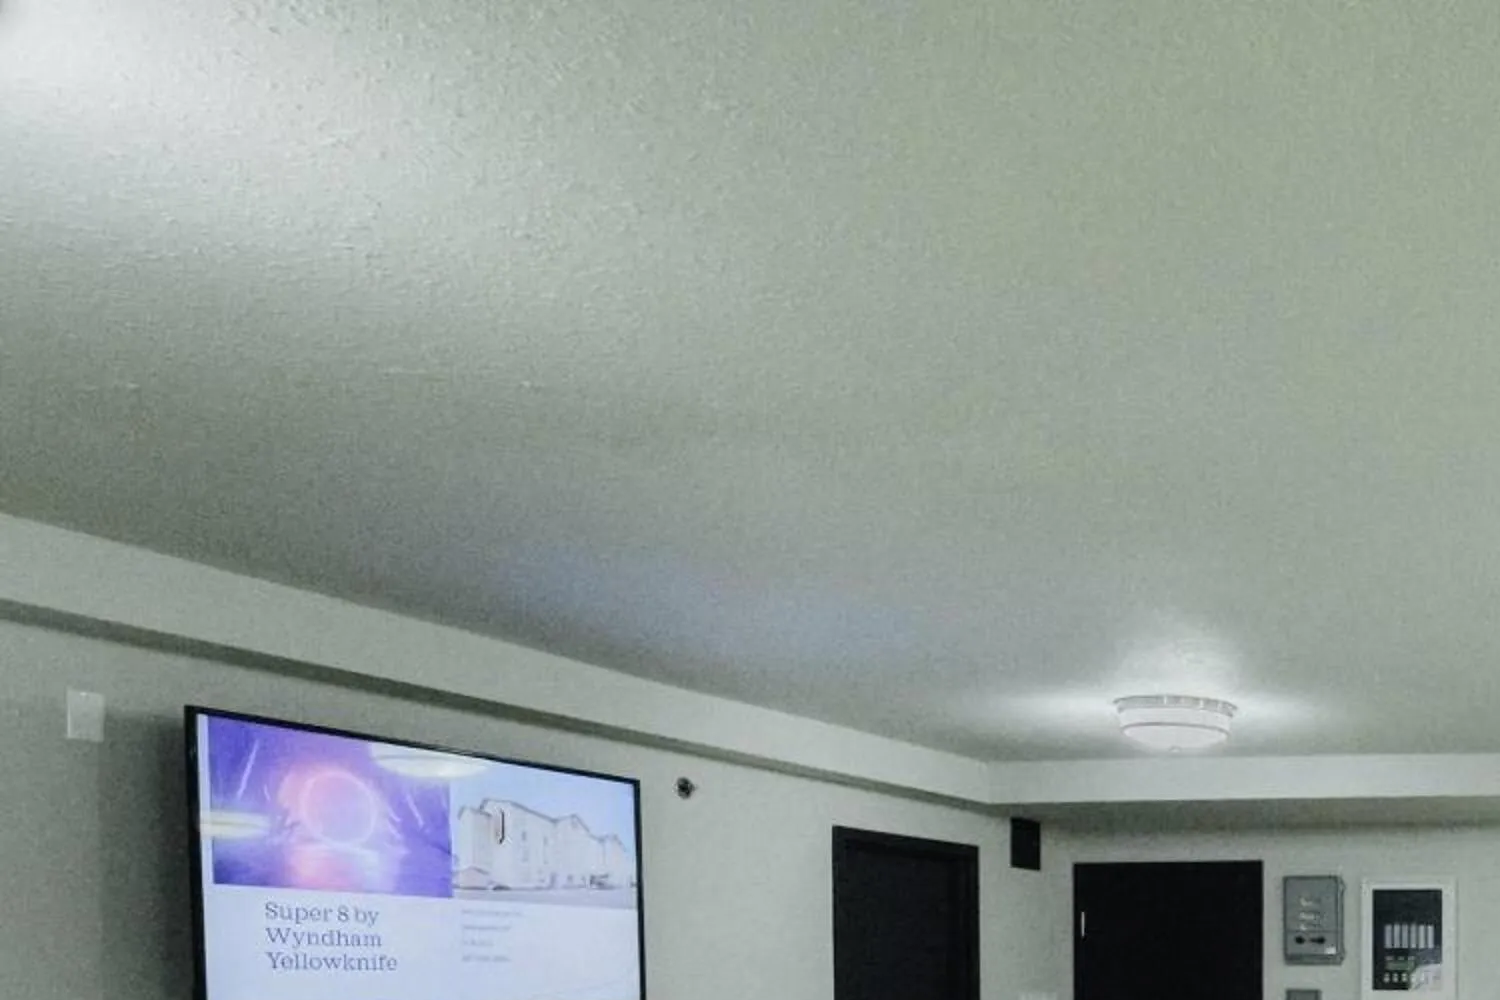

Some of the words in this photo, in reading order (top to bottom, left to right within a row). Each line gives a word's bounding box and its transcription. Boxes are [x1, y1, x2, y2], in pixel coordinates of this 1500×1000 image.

[265, 901, 333, 924] Super
[337, 905, 350, 922] 8
[354, 906, 380, 928] by
[265, 927, 382, 949] Wyndham
[265, 951, 398, 971] Yellowknife
